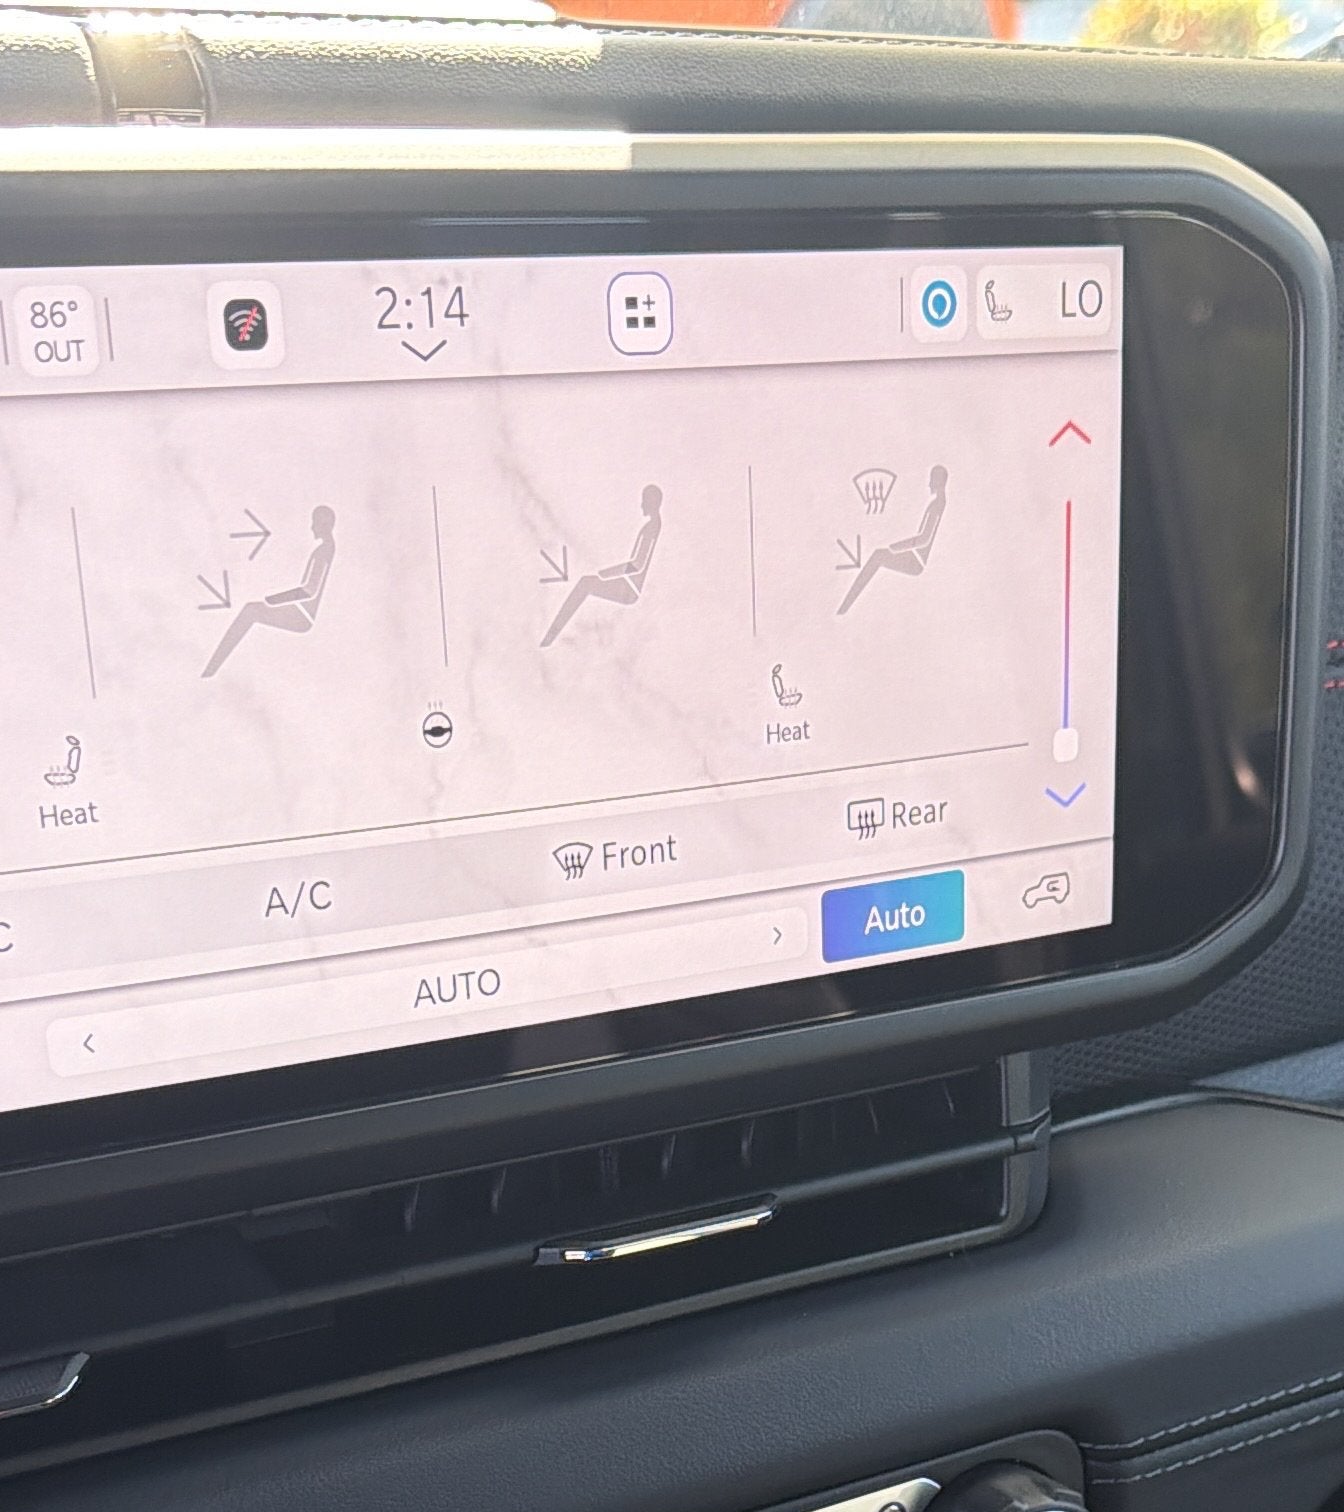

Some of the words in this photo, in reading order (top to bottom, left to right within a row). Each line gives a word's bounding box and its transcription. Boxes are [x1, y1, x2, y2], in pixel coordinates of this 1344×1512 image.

[30, 300, 79, 329] 86°
[374, 286, 470, 331] 2:14
[1061, 280, 1103, 319] LO
[34, 340, 86, 365] OUT
[765, 720, 812, 746] Heat
[38, 801, 100, 829] Heat
[891, 799, 949, 831] Rear
[601, 834, 679, 872] Front
[264, 880, 334, 918] A/C
[864, 900, 927, 936] Auto
[413, 968, 502, 1010] AUTO
